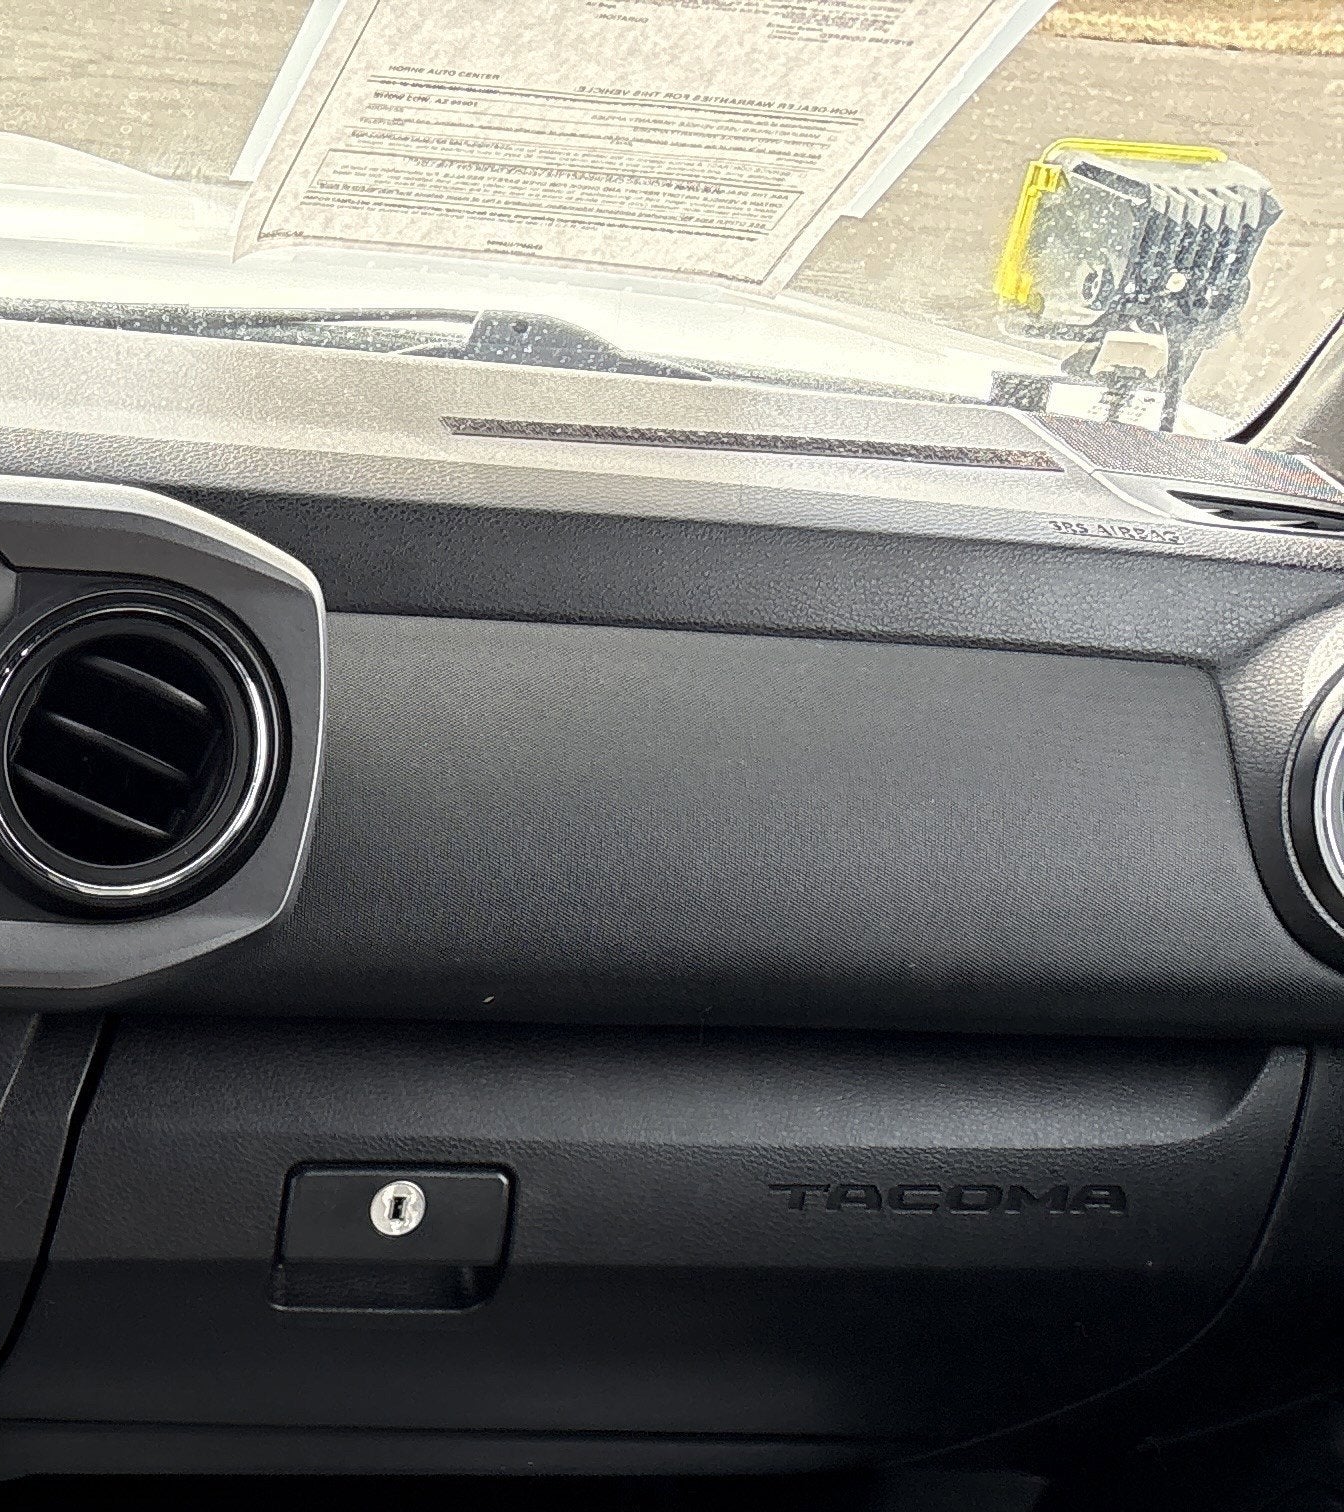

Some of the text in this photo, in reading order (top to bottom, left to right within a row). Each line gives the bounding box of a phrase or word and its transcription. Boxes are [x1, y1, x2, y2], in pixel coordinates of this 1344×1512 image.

[427, 69, 456, 77] AUTO
[458, 71, 501, 81] CENTER
[768, 1183, 1127, 1215] TACOMA
